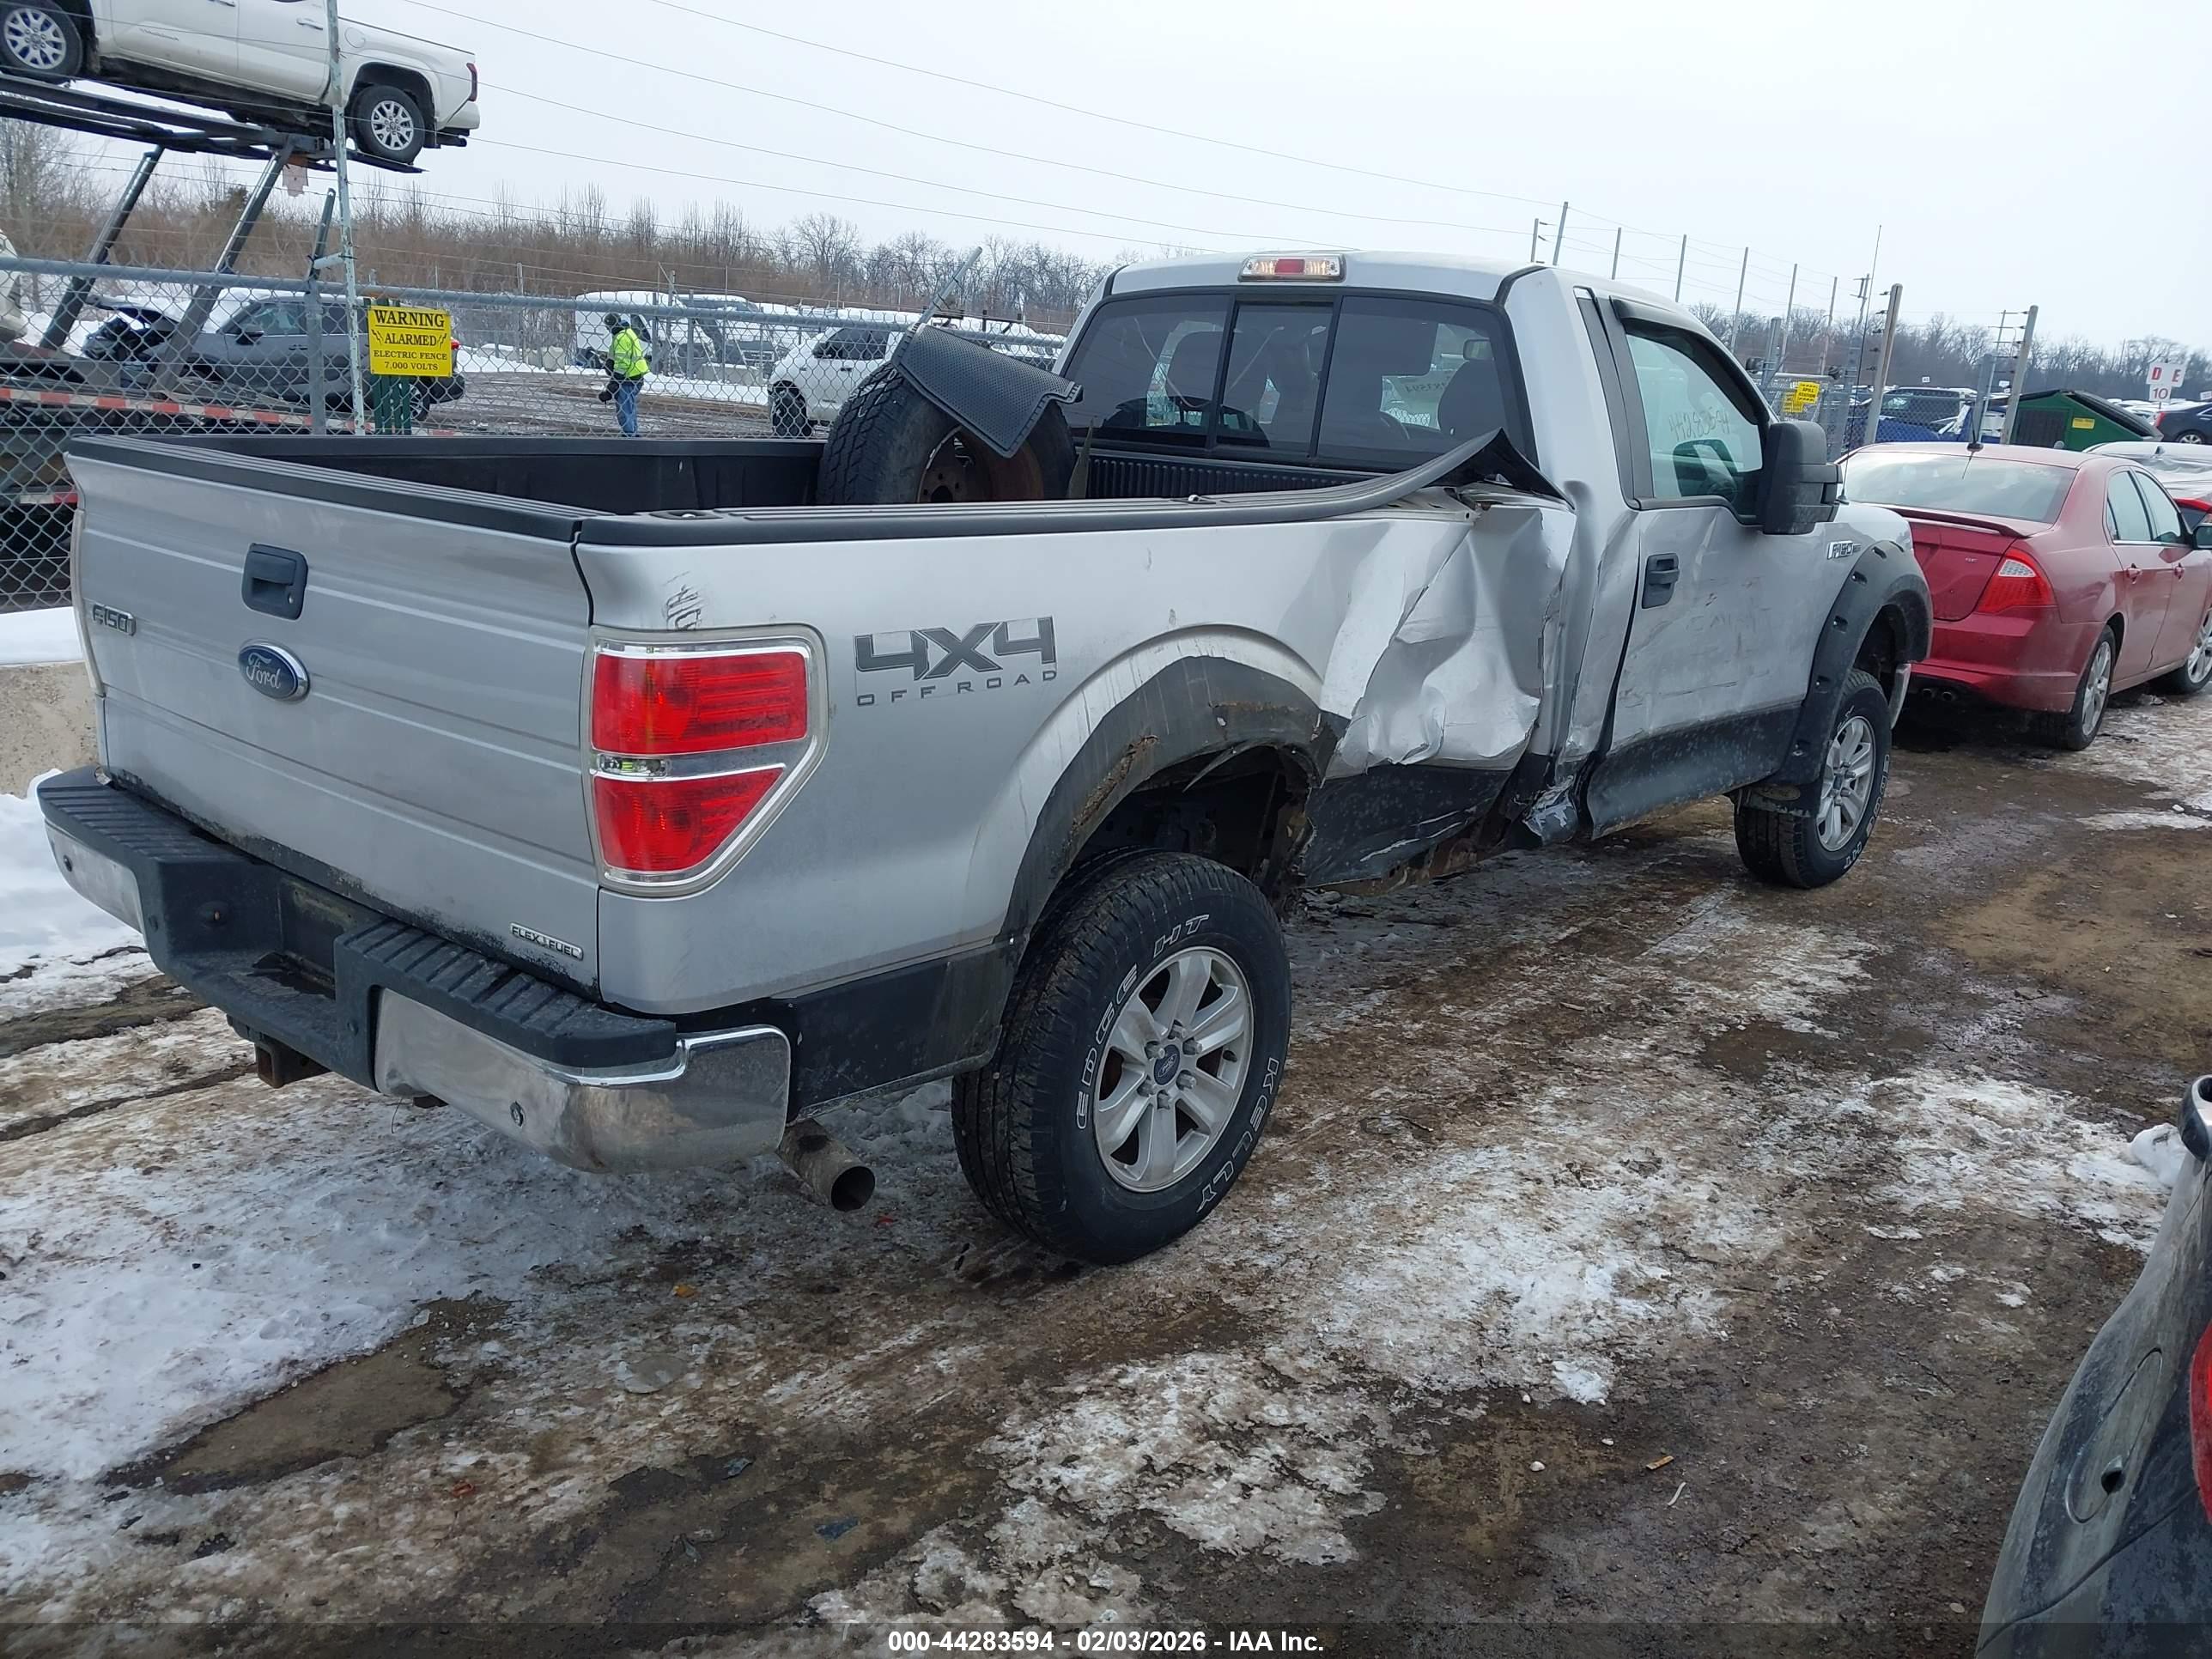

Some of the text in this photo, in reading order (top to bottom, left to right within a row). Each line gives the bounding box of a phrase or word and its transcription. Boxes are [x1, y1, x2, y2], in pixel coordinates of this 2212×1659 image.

[374, 309, 445, 327] WARNING
[384, 332, 437, 346] ALARMED
[374, 349, 447, 361] ELECTRIC FENCE
[384, 361, 439, 371] 7,000 VOLTS
[2151, 367, 2182, 383] D E
[2152, 387, 2169, 399] 10
[854, 617, 1056, 681] 4X4
[246, 652, 282, 690] Ford
[512, 926, 581, 959] FLEX FUEL
[1076, 914, 1210, 1130] EDGE HT
[1196, 1057, 1279, 1213] KELLY
